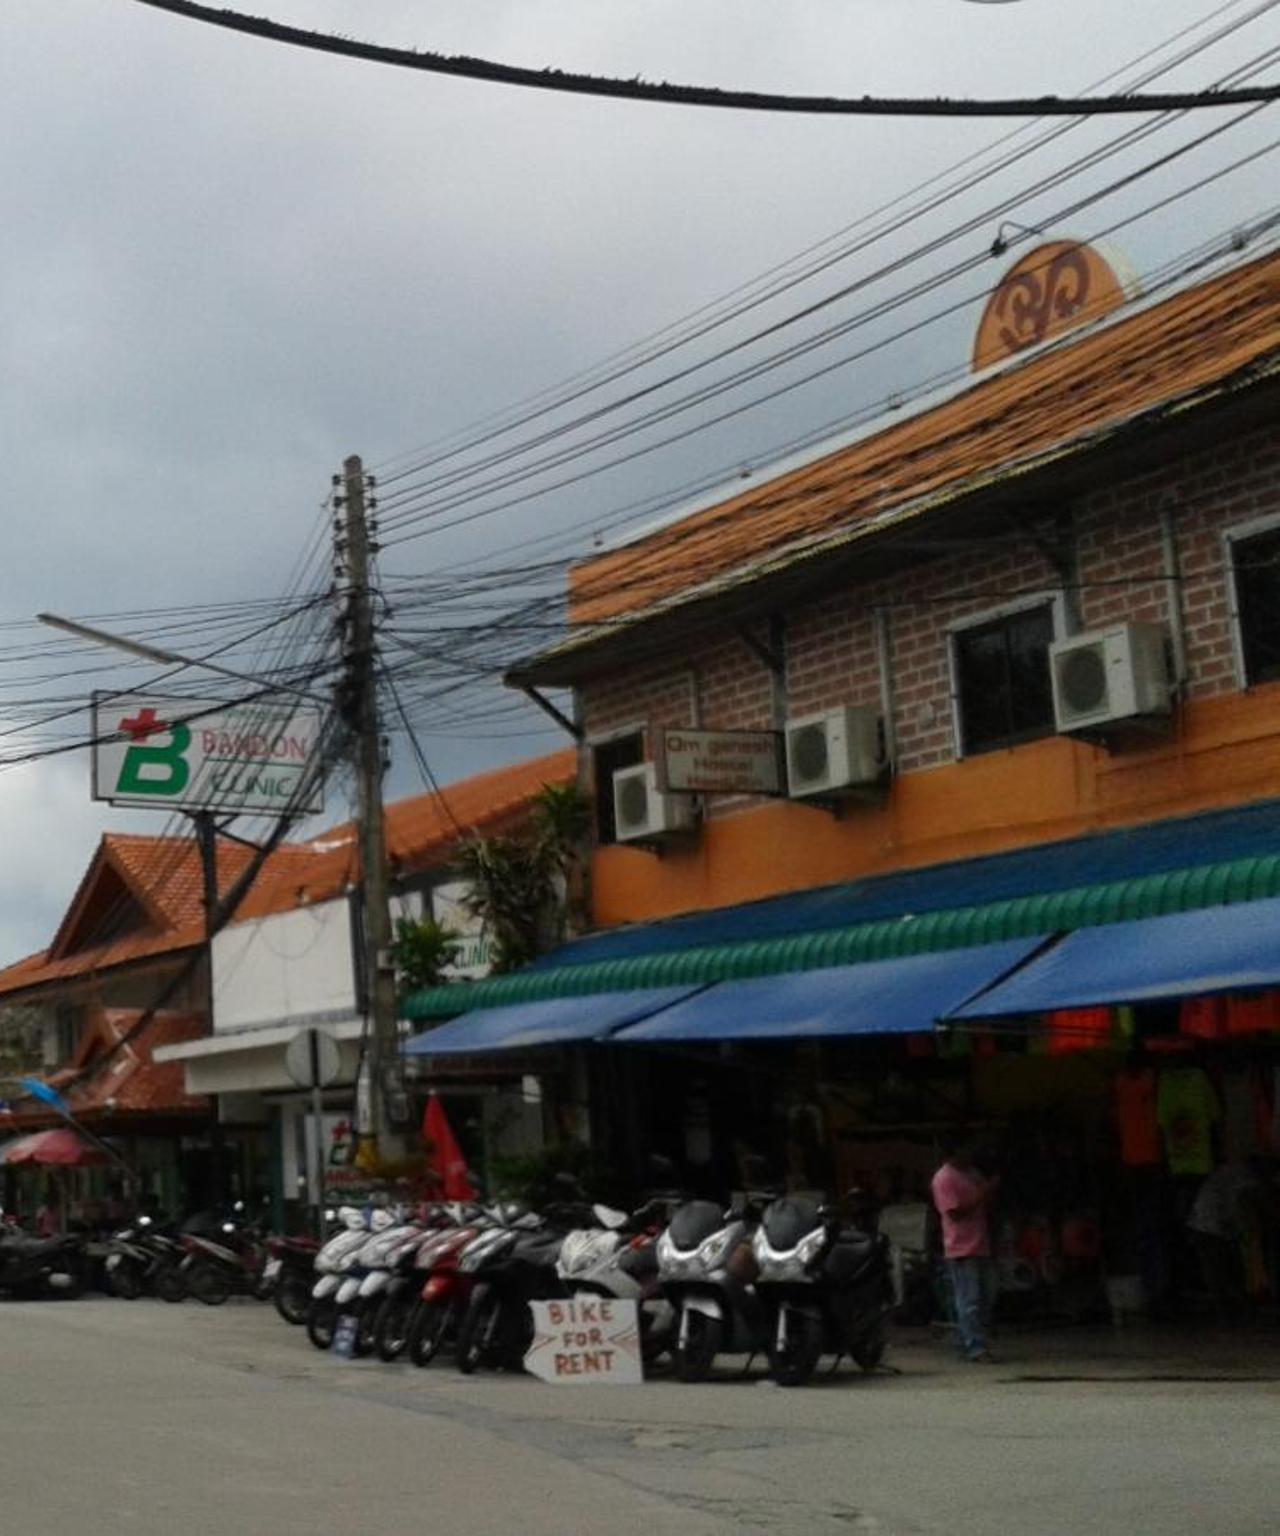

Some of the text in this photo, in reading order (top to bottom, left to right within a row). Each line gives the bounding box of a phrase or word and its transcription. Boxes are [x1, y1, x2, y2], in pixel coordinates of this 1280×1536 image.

[548, 1301, 613, 1325] BIKE
[563, 1327, 603, 1347] FOR
[554, 1350, 614, 1375] RENT
